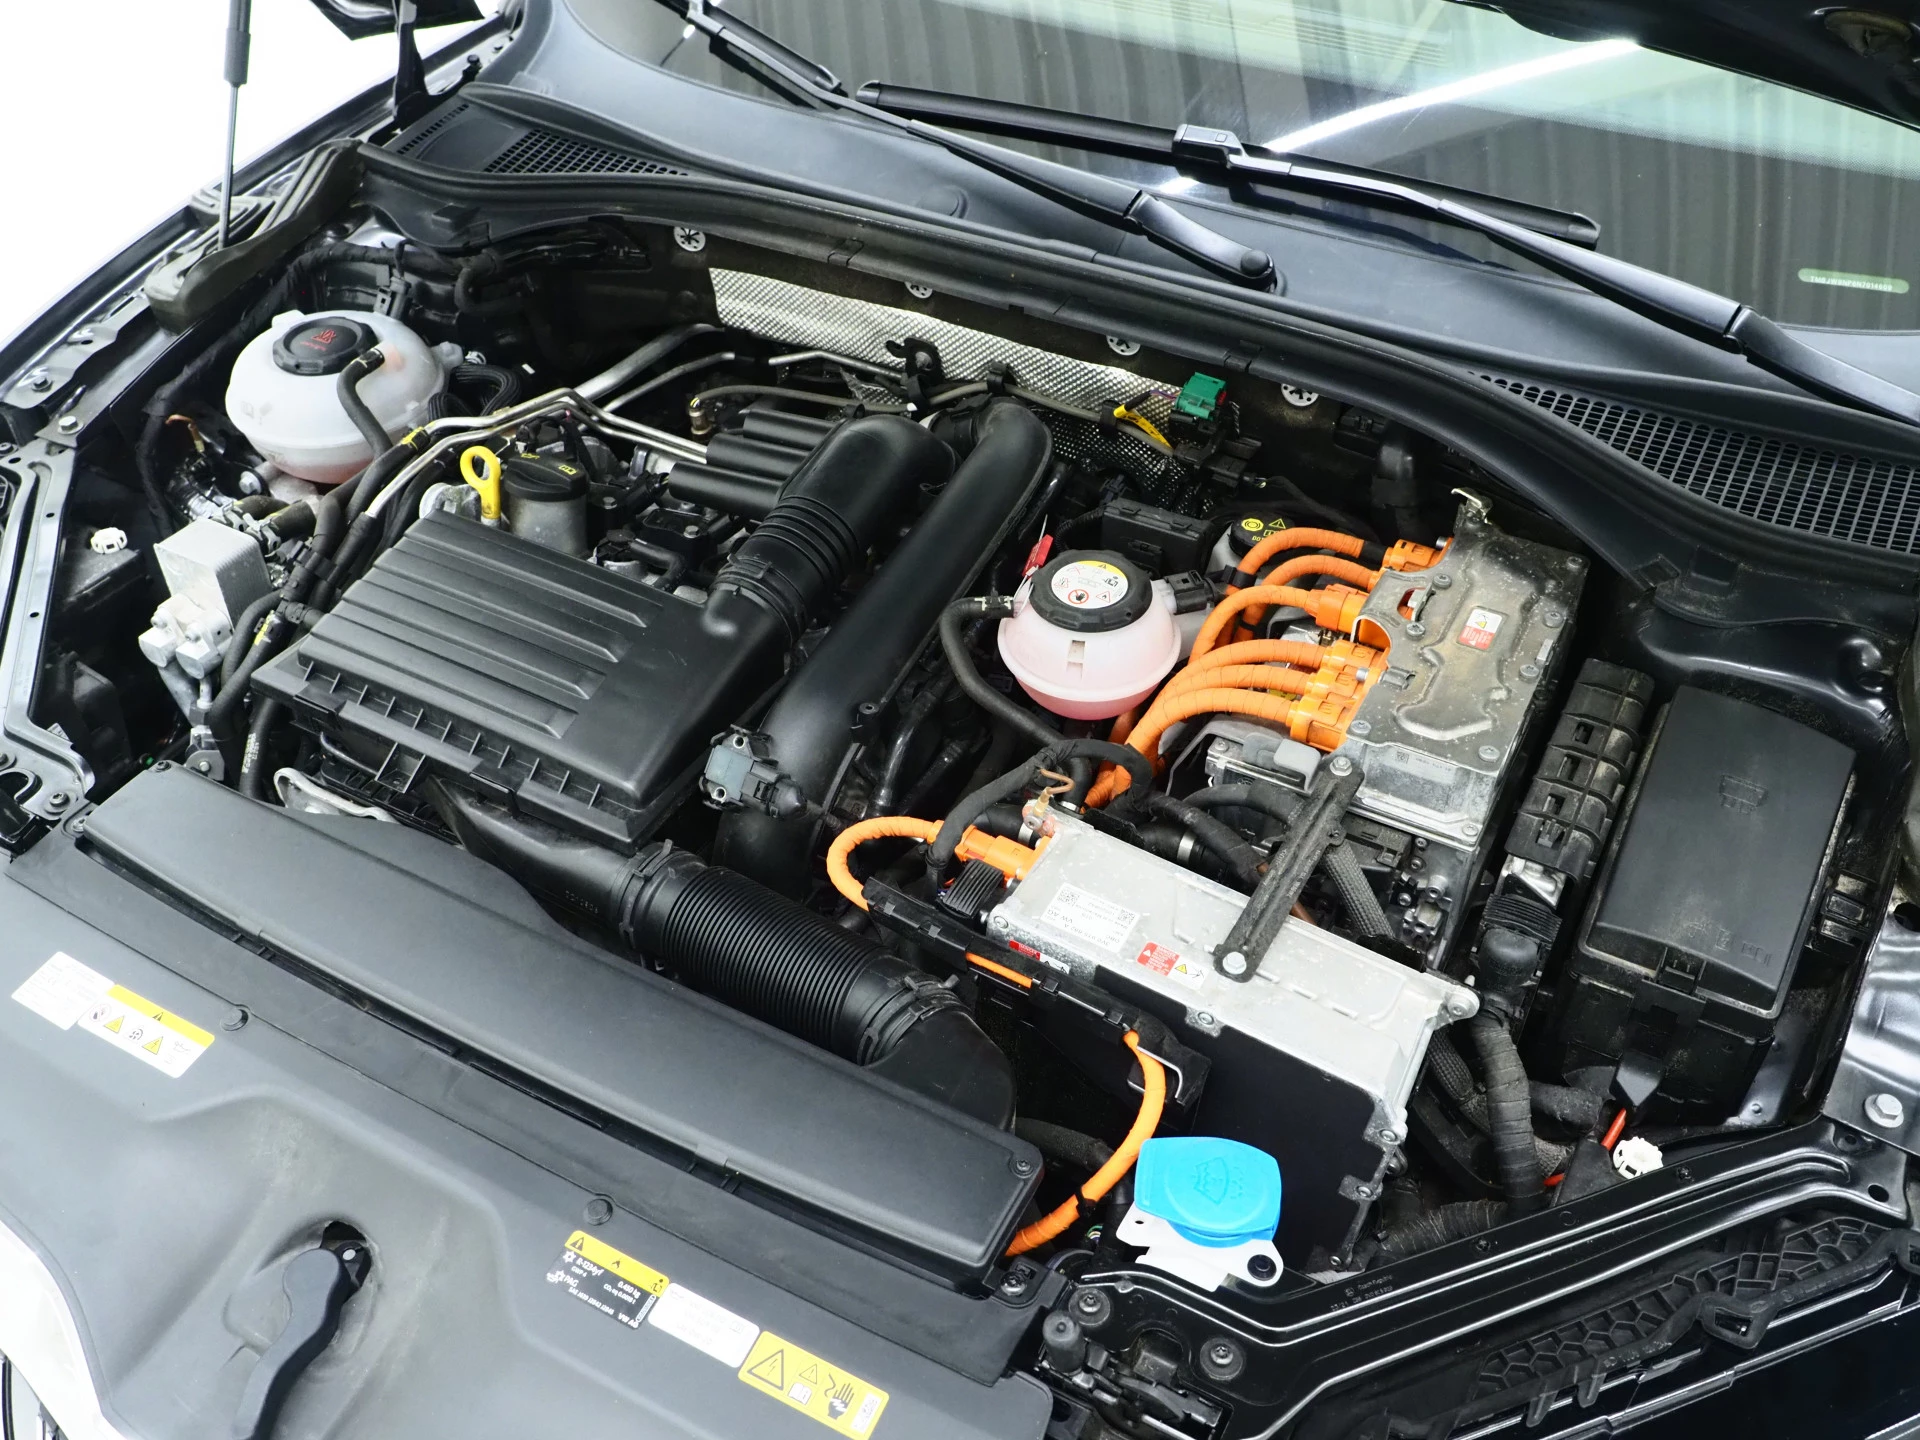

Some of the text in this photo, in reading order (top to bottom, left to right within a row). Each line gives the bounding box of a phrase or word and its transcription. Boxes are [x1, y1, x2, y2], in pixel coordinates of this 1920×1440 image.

[576, 1258, 604, 1276] R-1234yf
[564, 1275, 579, 1287] PAG
[618, 1281, 641, 1298] 0.450 kg
[618, 1313, 639, 1328] VW AG
